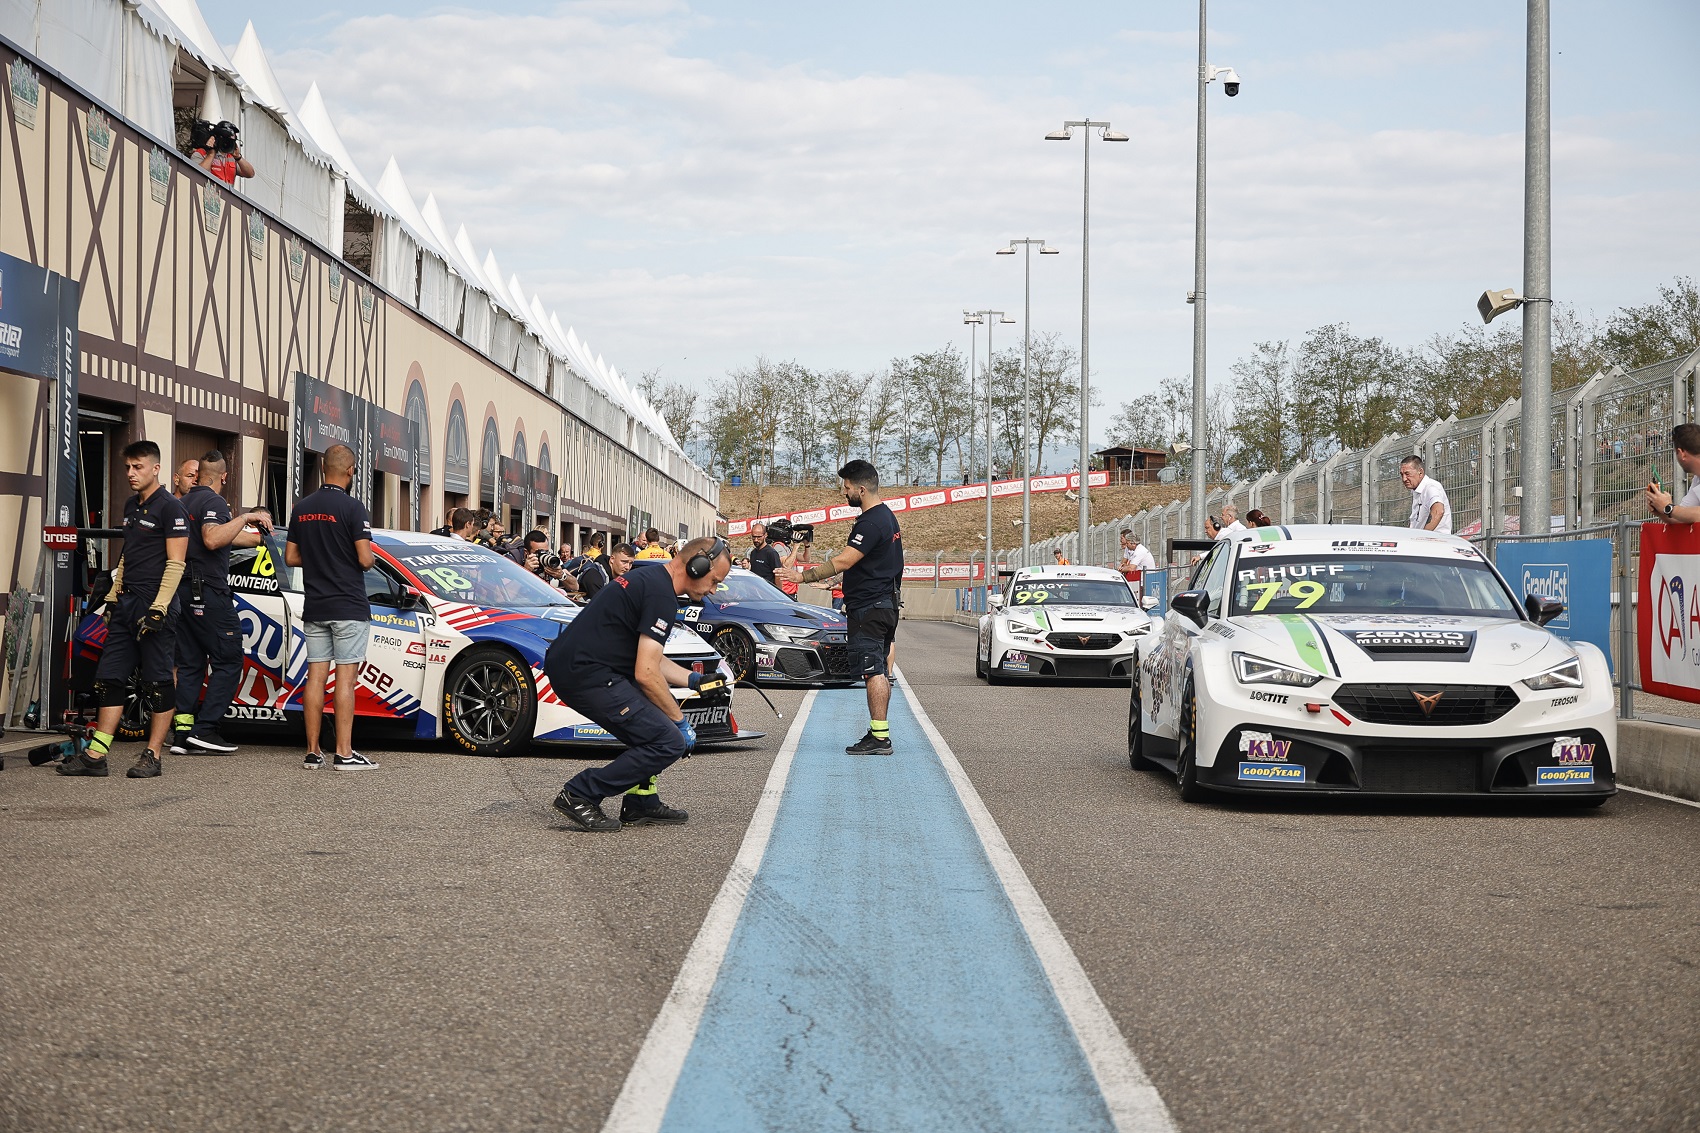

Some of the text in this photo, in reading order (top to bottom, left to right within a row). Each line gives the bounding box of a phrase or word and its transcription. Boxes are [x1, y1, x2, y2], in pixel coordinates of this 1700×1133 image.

[63, 326, 72, 459] MONTEIRO
[923, 494, 943, 502] ALSACE
[298, 513, 337, 523] HONDA
[803, 512, 825, 521] ALSACE
[730, 523, 745, 531] SACE
[43, 530, 77, 543] brose
[417, 567, 472, 592] 18
[1238, 564, 1344, 582] R.HUFF
[227, 574, 279, 592] MONTEIRO
[1015, 583, 1064, 592] D.NAGY
[1015, 591, 1049, 604] 99
[1246, 581, 1326, 612] 79
[686, 609, 698, 618] 25
[370, 613, 416, 628] ODYEAR
[381, 635, 402, 647] PAGID
[430, 639, 451, 648] HRC
[1356, 638, 1465, 646] MOTORSPORT
[428, 654, 446, 663] JAS
[505, 660, 527, 689] EAGLE
[1250, 691, 1289, 704] LOCTITE
[1550, 695, 1579, 707] TEROSON
[224, 705, 287, 721] ONDA
[1247, 740, 1292, 758] KW
[1559, 743, 1596, 763] KW
[1243, 766, 1302, 778] GOODYEAR
[1541, 769, 1591, 782] GOODYEAR
